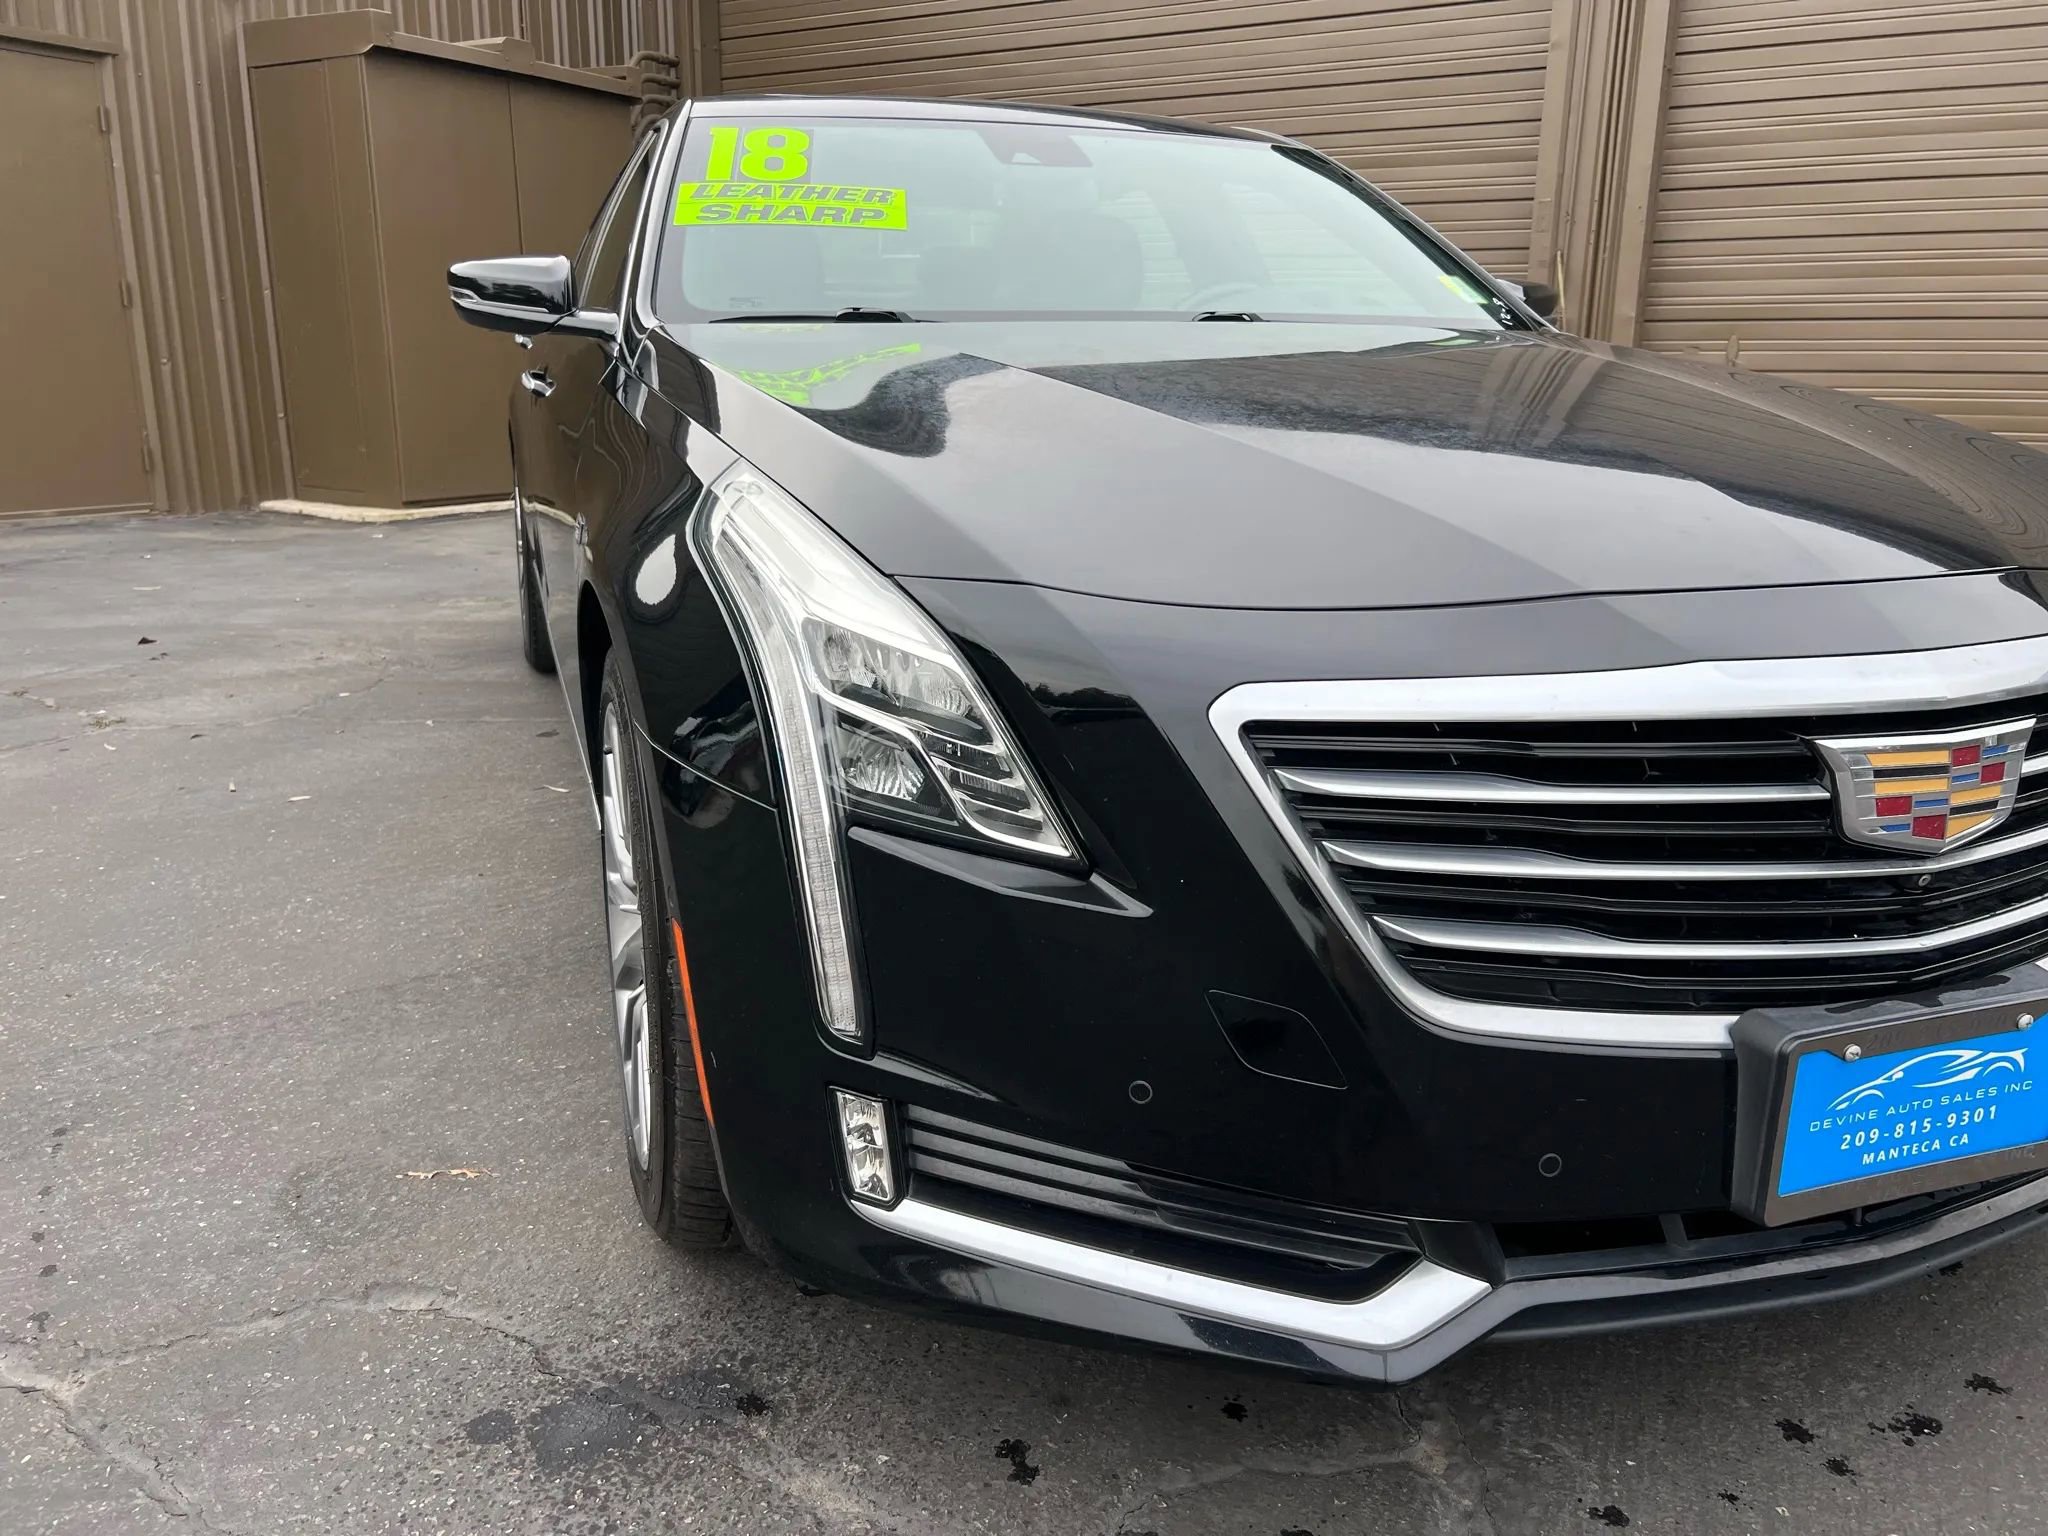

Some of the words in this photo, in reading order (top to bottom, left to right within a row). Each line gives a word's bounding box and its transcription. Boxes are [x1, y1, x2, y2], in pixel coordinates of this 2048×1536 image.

[705, 127, 811, 182] 18
[690, 183, 897, 205] LEATHER
[696, 203, 887, 224] SHARP
[1809, 1109, 1879, 1132] DEVINE
[1886, 1099, 1933, 1117] AUTO
[1940, 1086, 1998, 1106] SALES
[2004, 1080, 2033, 1094] INC
[1840, 1104, 1997, 1150] 209-815-9301
[1862, 1139, 1941, 1165] MANTECA
[1949, 1133, 1970, 1147] CA
